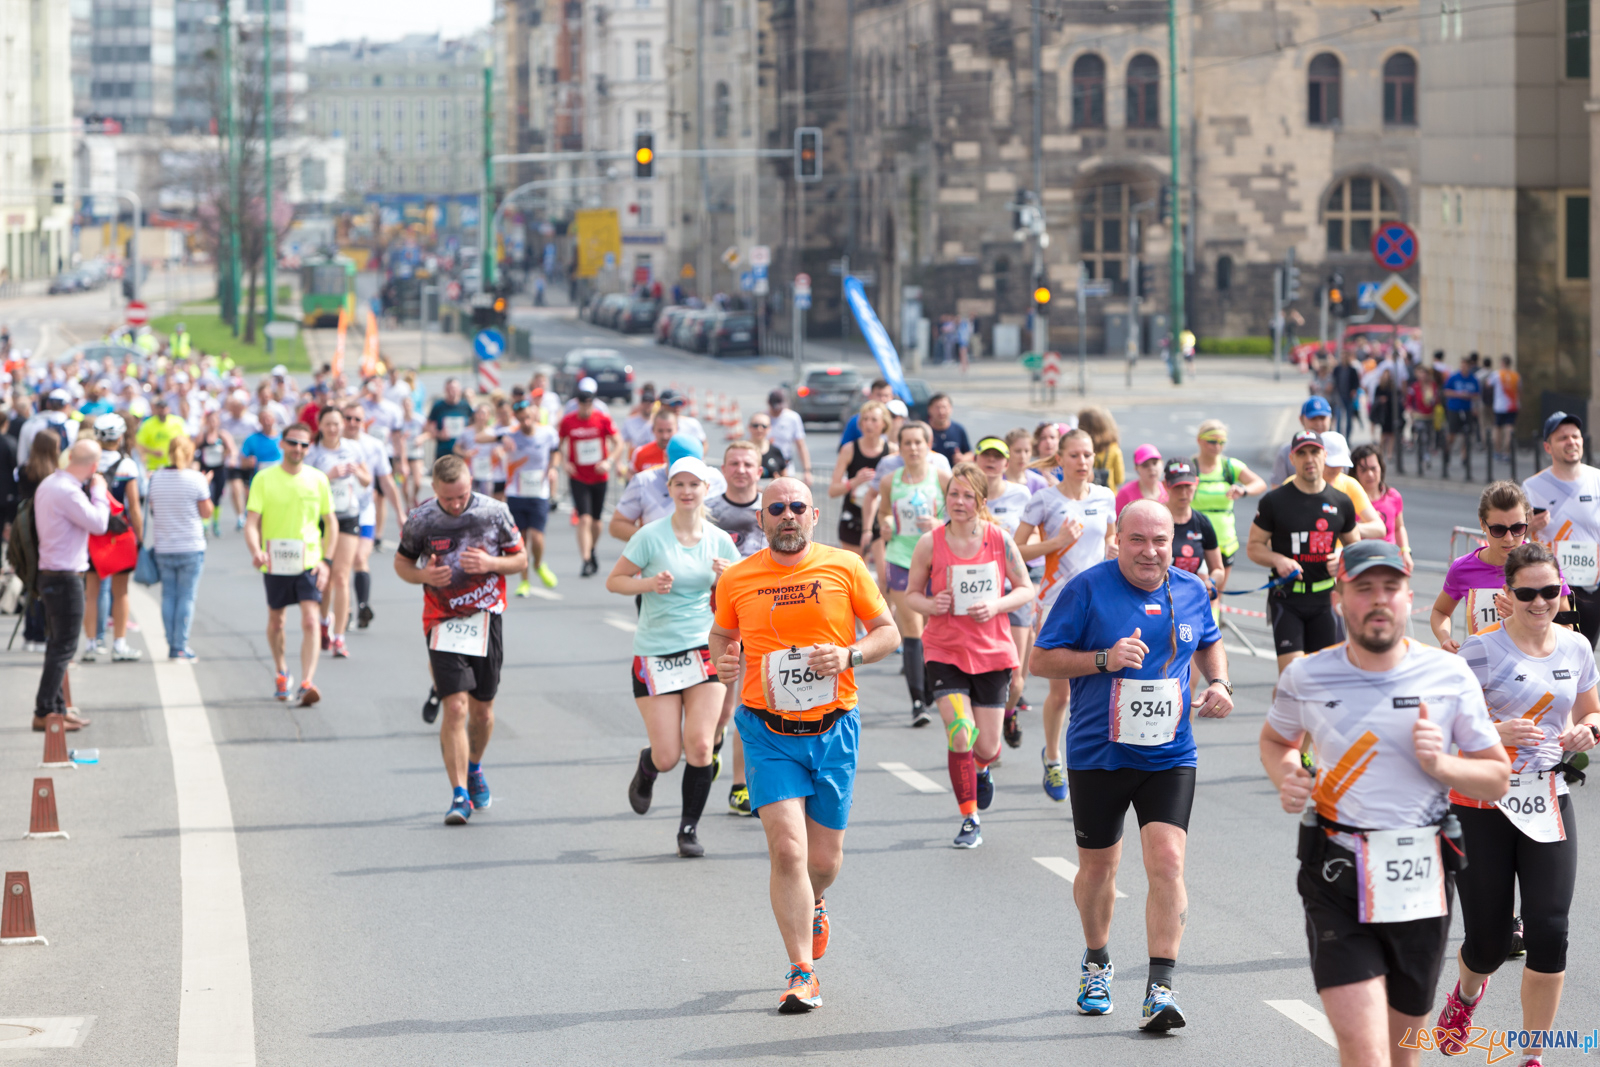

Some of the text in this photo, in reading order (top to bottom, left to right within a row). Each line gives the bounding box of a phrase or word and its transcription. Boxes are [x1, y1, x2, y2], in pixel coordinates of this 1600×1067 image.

[1300, 553, 1327, 563] FINISH
[1562, 554, 1595, 567] 11886
[757, 584, 806, 596] POMORZE
[960, 579, 993, 594] 8672
[773, 592, 805, 602] BIEGA
[446, 621, 478, 637] 9575
[653, 653, 692, 673] 3046
[1130, 700, 1172, 718] 9341
[1386, 856, 1432, 882] 5247
